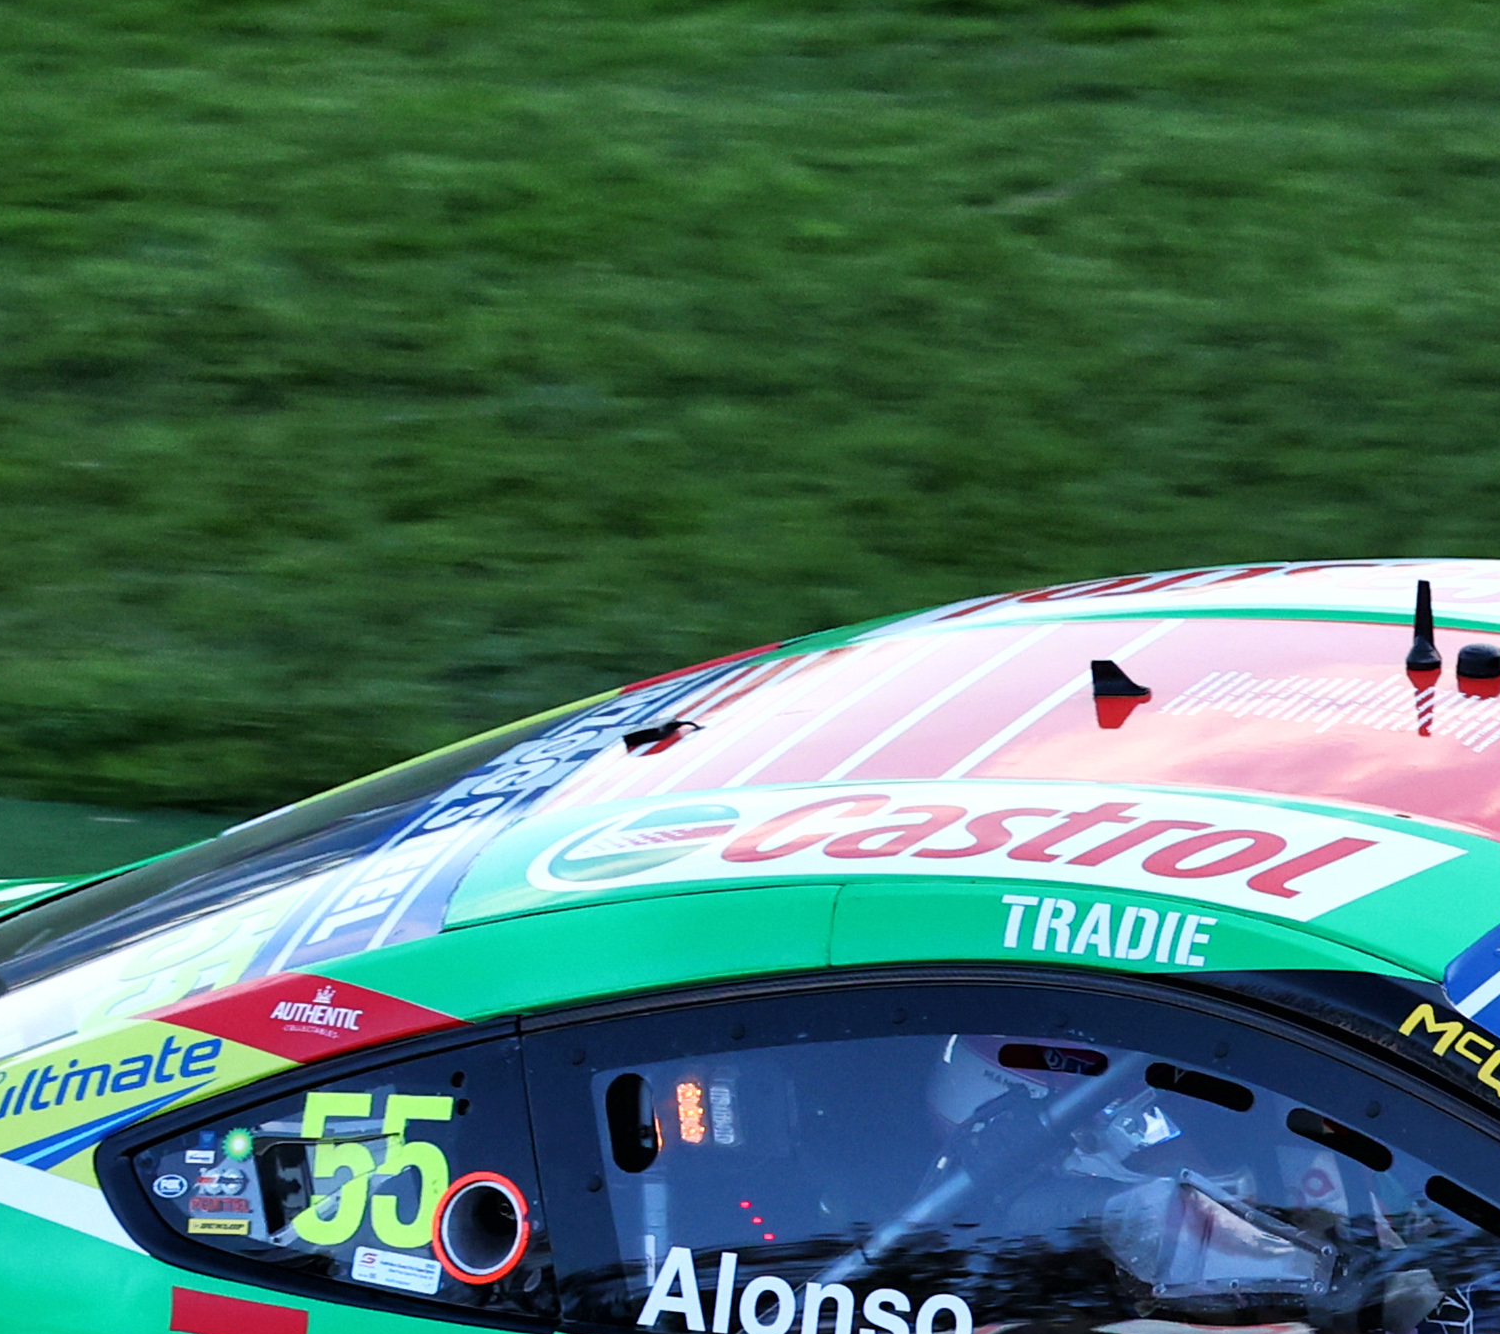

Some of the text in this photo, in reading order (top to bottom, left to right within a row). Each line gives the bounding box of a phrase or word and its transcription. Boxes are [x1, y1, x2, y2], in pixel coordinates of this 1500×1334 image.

[722, 794, 1379, 898] Castrol
[1002, 894, 1217, 967] TRADIE
[270, 1001, 364, 1030] AUTHENTIC
[292, 1092, 453, 1247] 55
